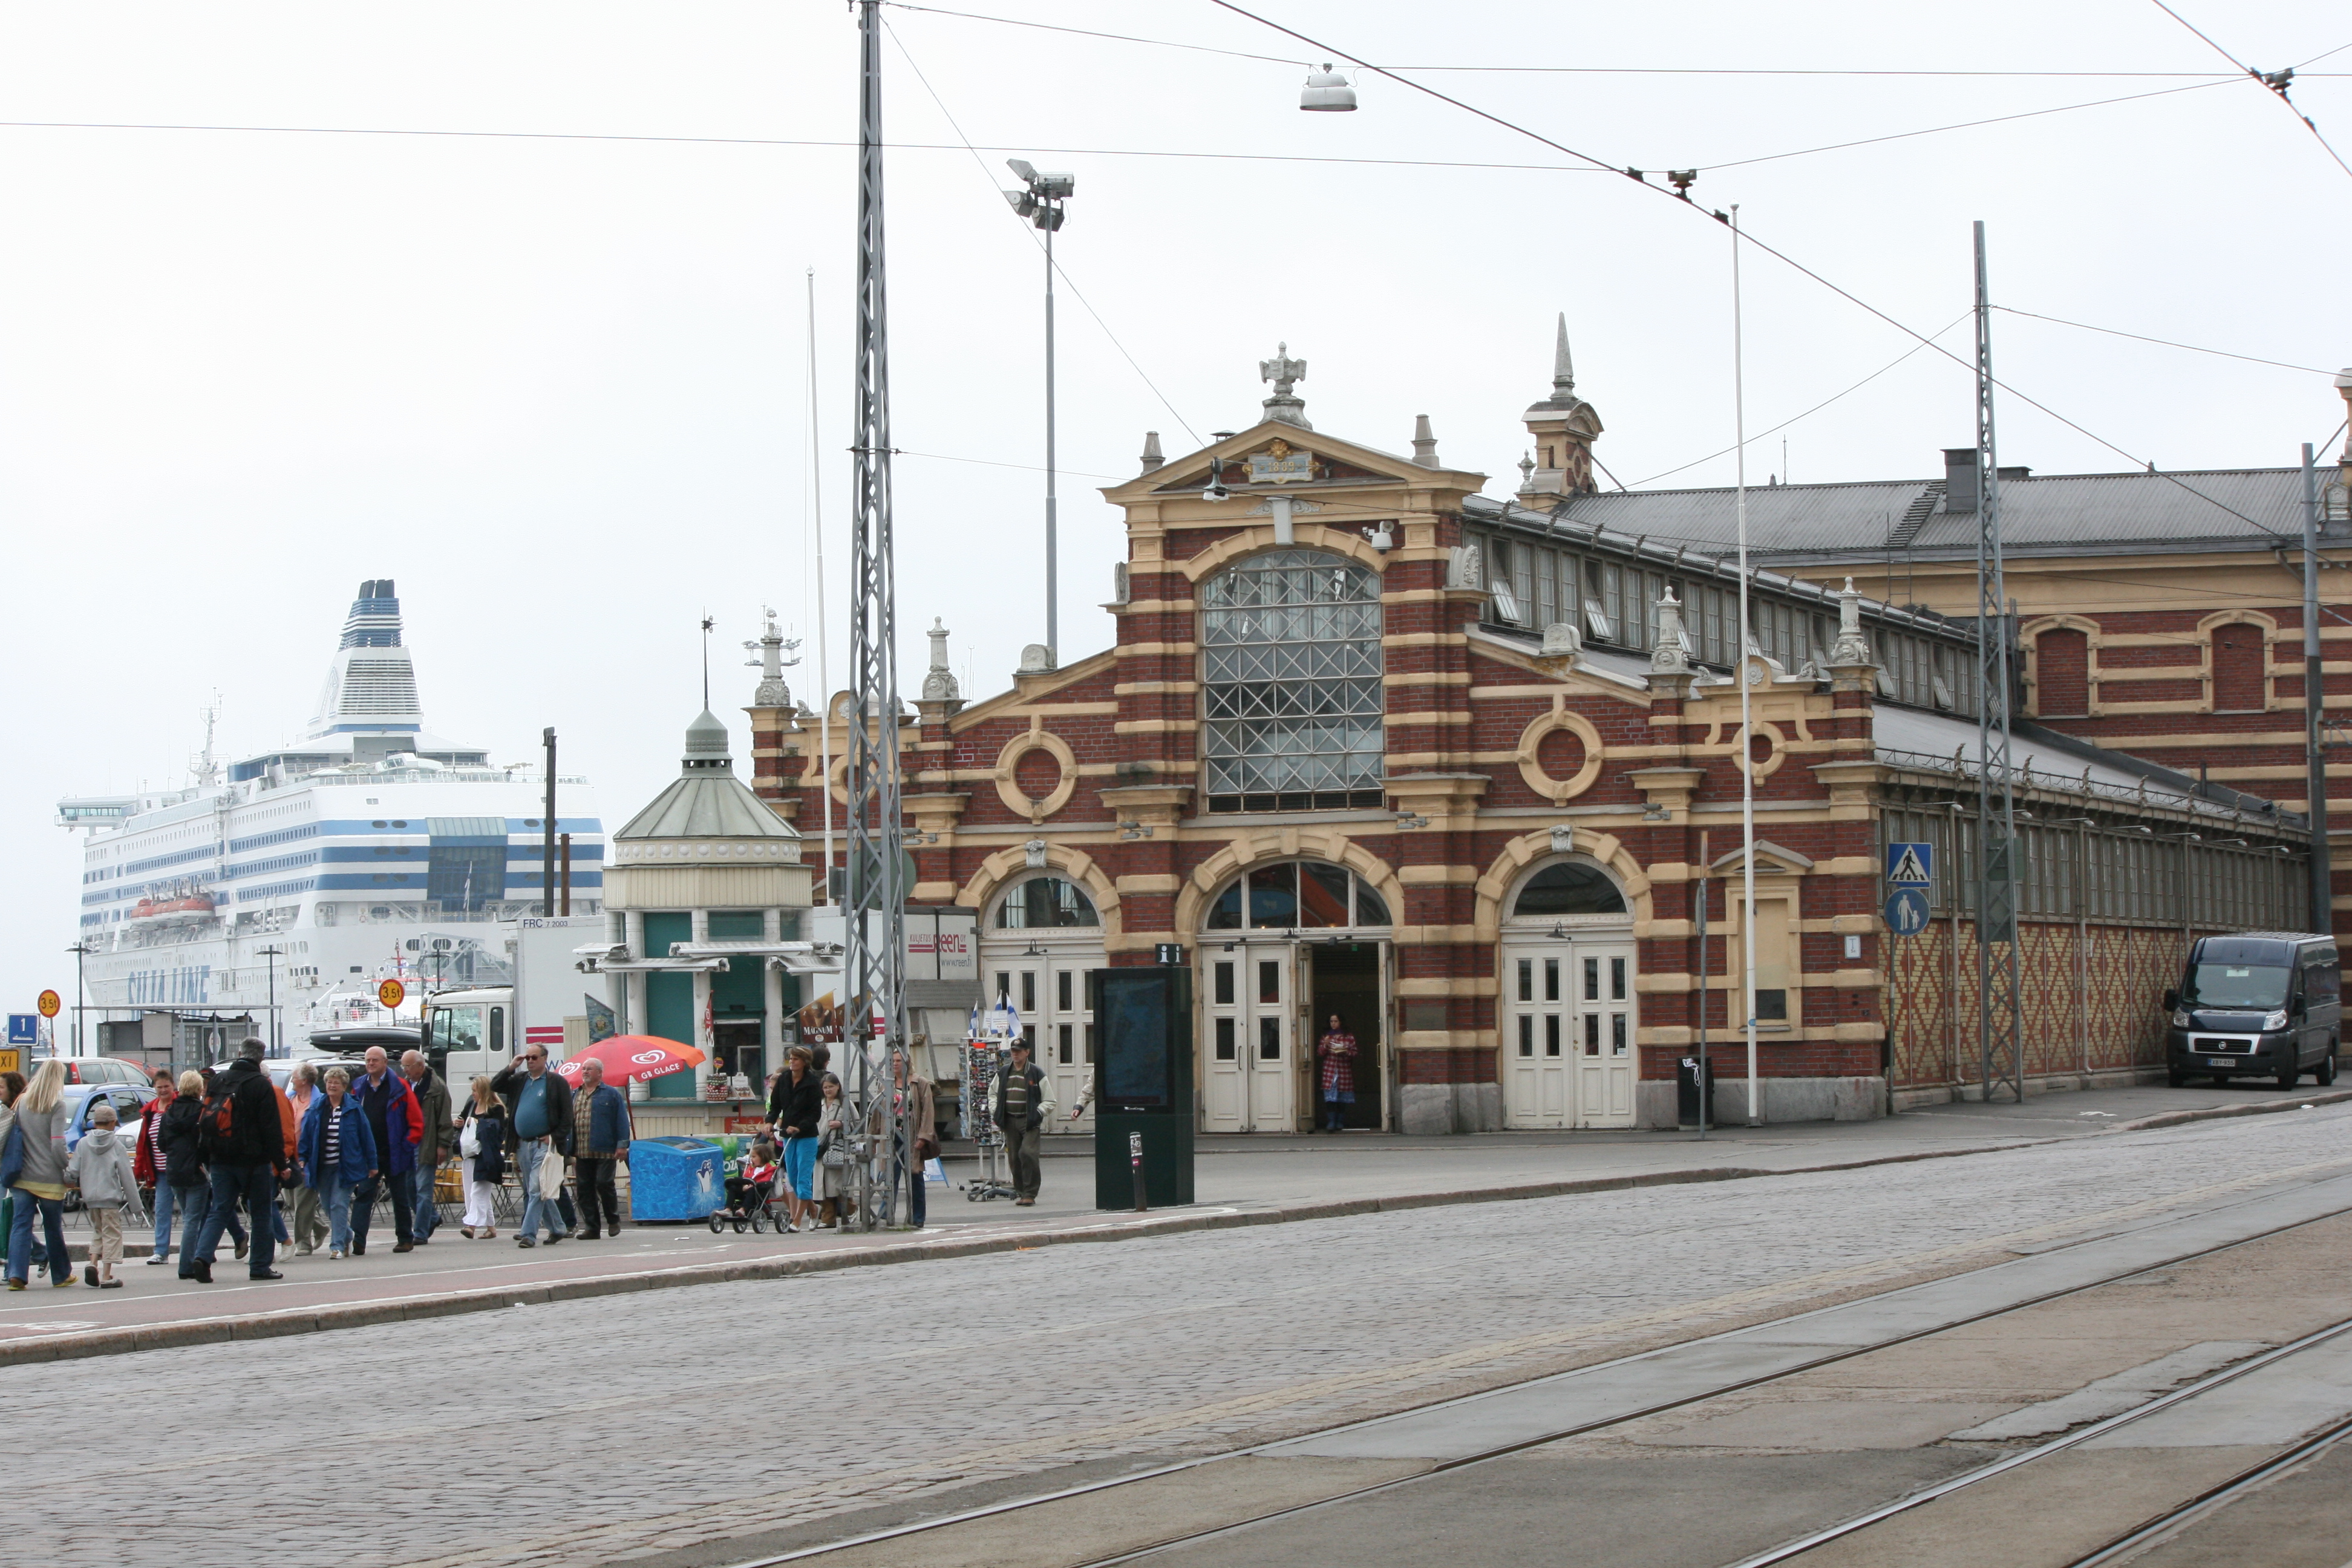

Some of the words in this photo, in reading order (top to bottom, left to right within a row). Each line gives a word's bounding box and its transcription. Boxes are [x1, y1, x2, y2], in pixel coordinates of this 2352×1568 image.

[1268, 462, 1294, 472] 1889
[523, 918, 543, 928] FRC
[910, 934, 931, 943] KULJETUS
[941, 955, 972, 967] www.reen.fi
[21, 1018, 26, 1031] 1
[804, 1025, 833, 1035] MAGNUM
[1, 1056, 11, 1067] XI
[641, 1071, 653, 1079] GB
[654, 1063, 680, 1074] GLACE
